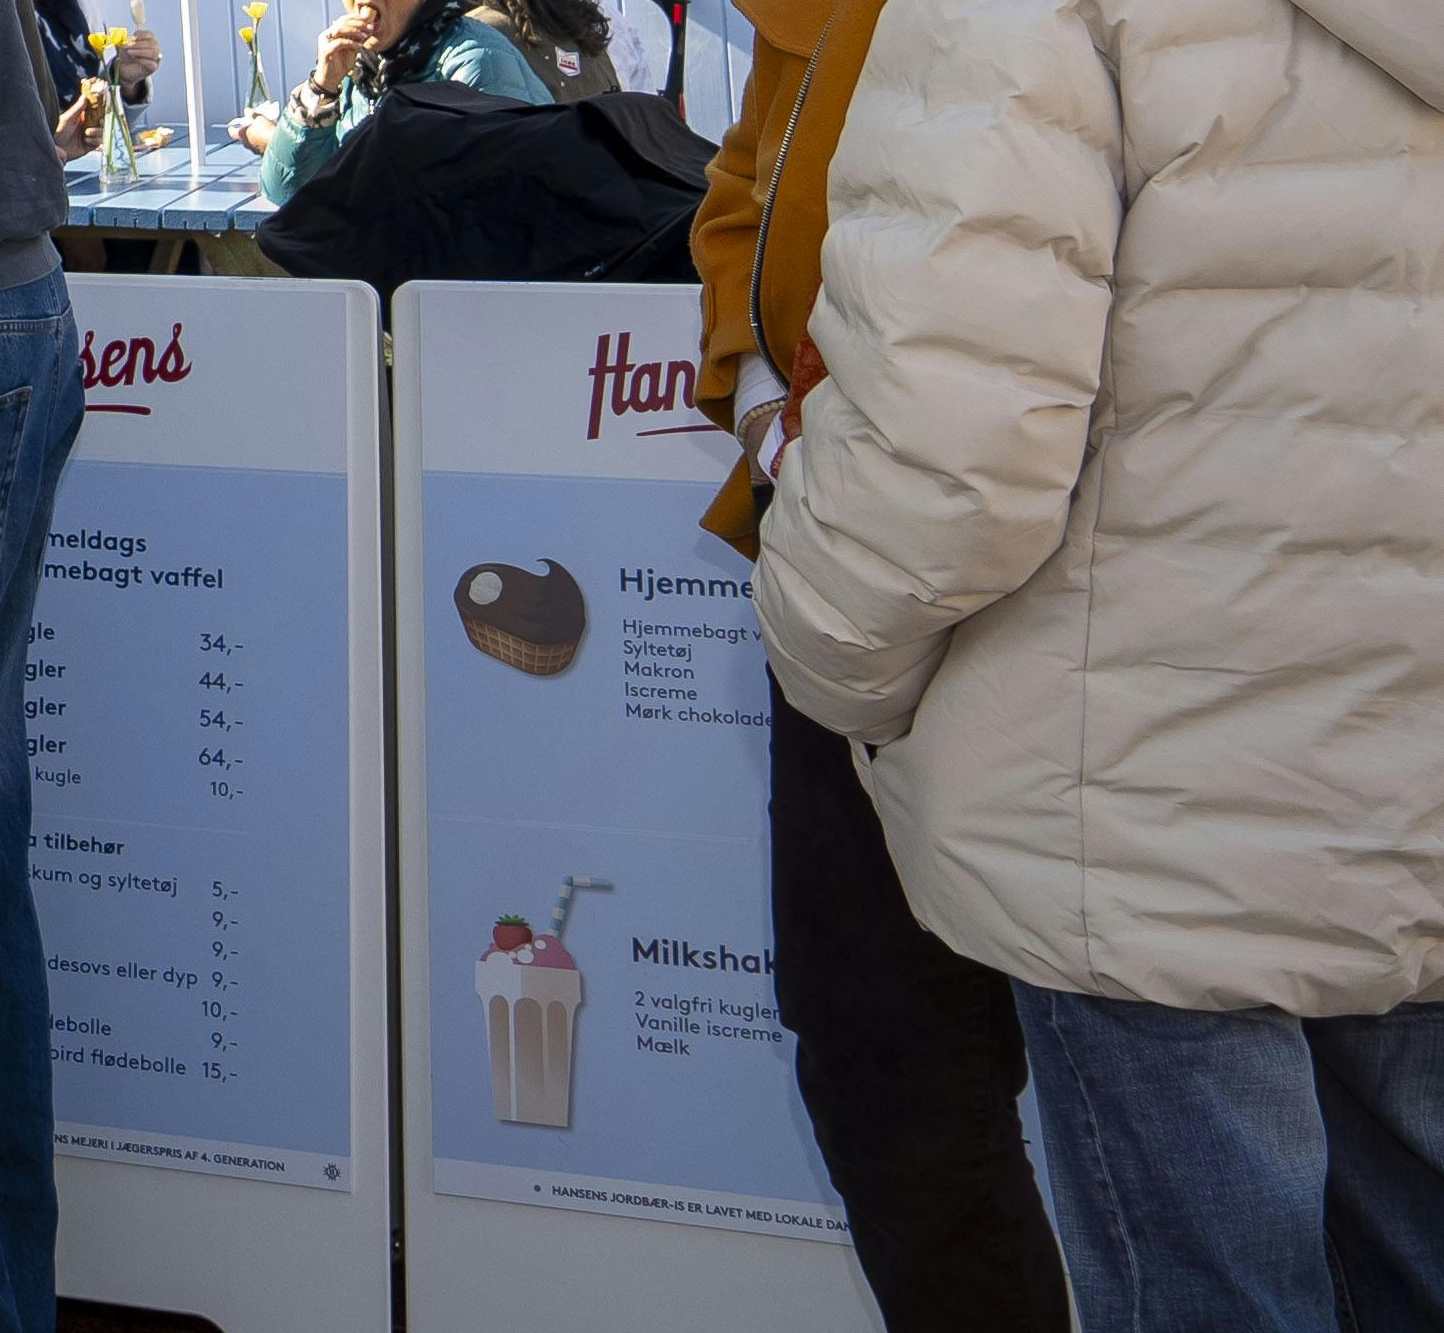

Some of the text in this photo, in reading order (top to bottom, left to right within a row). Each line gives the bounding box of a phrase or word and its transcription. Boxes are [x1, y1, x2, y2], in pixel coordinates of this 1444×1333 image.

[45, 561, 222, 588] mebagt vaffel
[623, 619, 747, 640] Hjemmebagt
[624, 640, 691, 662] Syltetøj
[625, 661, 694, 679] Makron
[625, 682, 697, 700] Iscreme
[626, 703, 672, 720] Mørk
[43, 833, 124, 855] tilbehør
[632, 938, 776, 975] Milkshak
[117, 962, 237, 991] eller dyp 9,-
[635, 991, 780, 1021] 2 valgfri kugler
[635, 1013, 783, 1042] Vanille iscreme
[637, 1035, 690, 1055] Mælk
[71, 1136, 107, 1149] MEJERI
[116, 1142, 182, 1158] JÆGERSPRIS
[185, 1151, 198, 1160] AF
[201, 1153, 211, 1162] 4.
[214, 1154, 284, 1171] GENERATION
[553, 1186, 607, 1201] HANSENS
[610, 1193, 685, 1211] JORDBÆR-IS
[688, 1203, 703, 1213] ER
[706, 1205, 743, 1218] LAVET
[746, 1210, 772, 1221] MED
[775, 1213, 823, 1229] LOKALE
